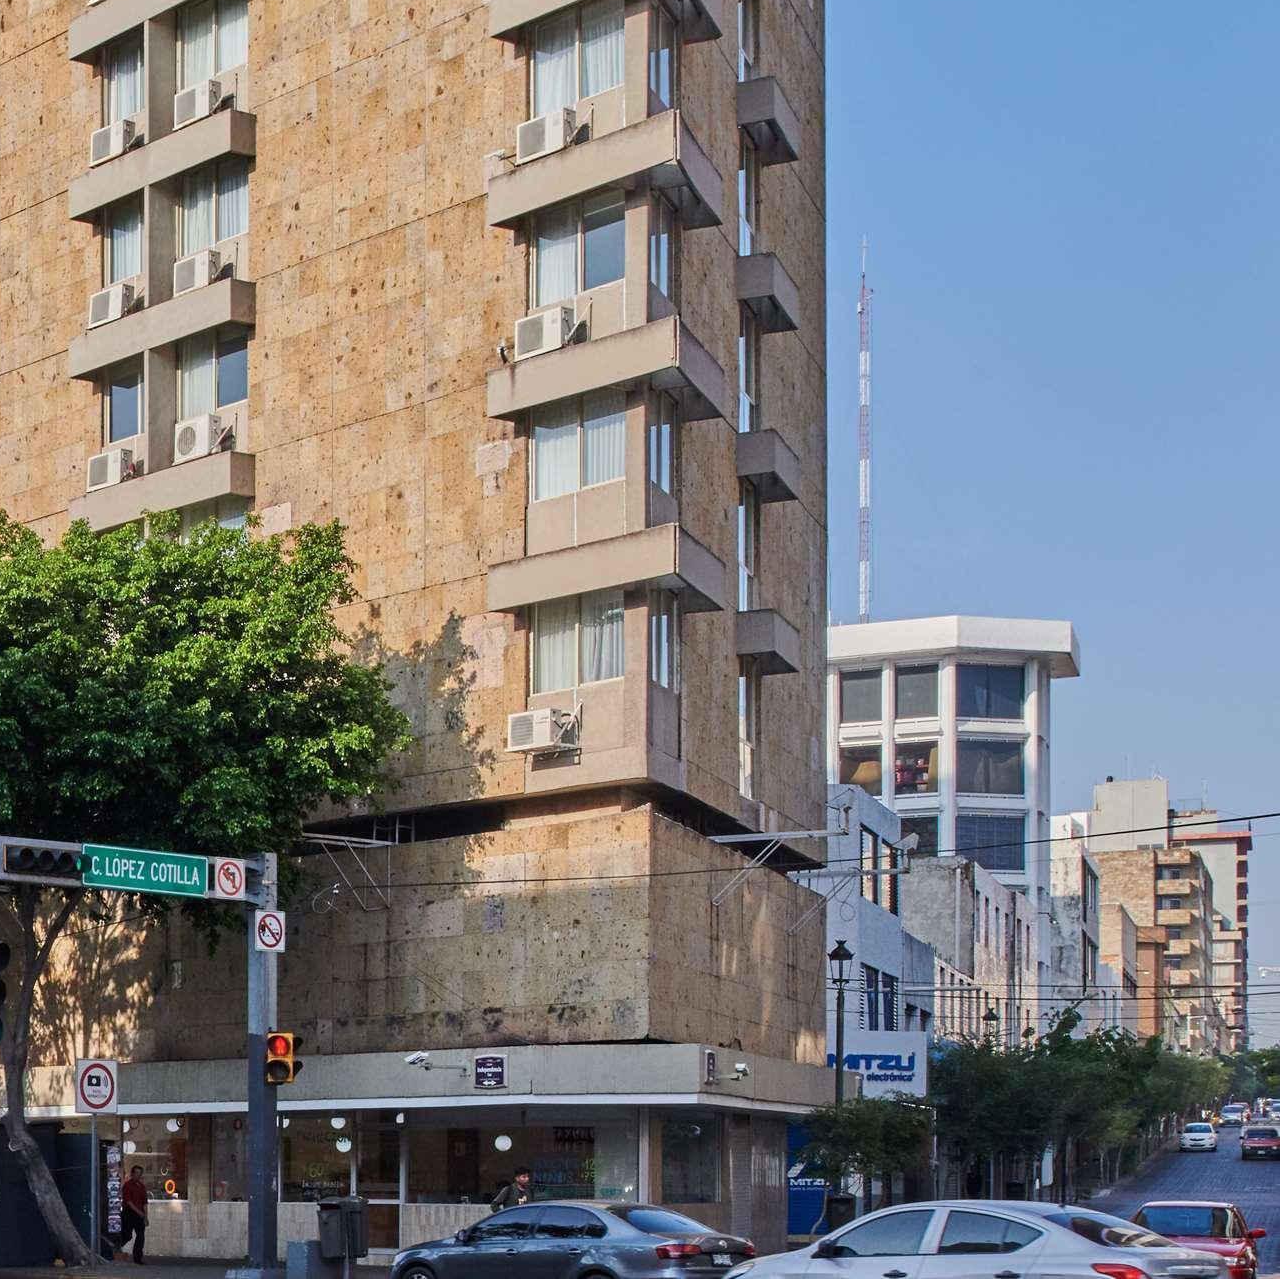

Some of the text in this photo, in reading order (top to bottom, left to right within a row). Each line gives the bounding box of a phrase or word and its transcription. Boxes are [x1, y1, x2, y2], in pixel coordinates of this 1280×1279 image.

[91, 853, 200, 886] C. LÓPEZ COTILLA
[827, 1053, 915, 1071] MITZU
